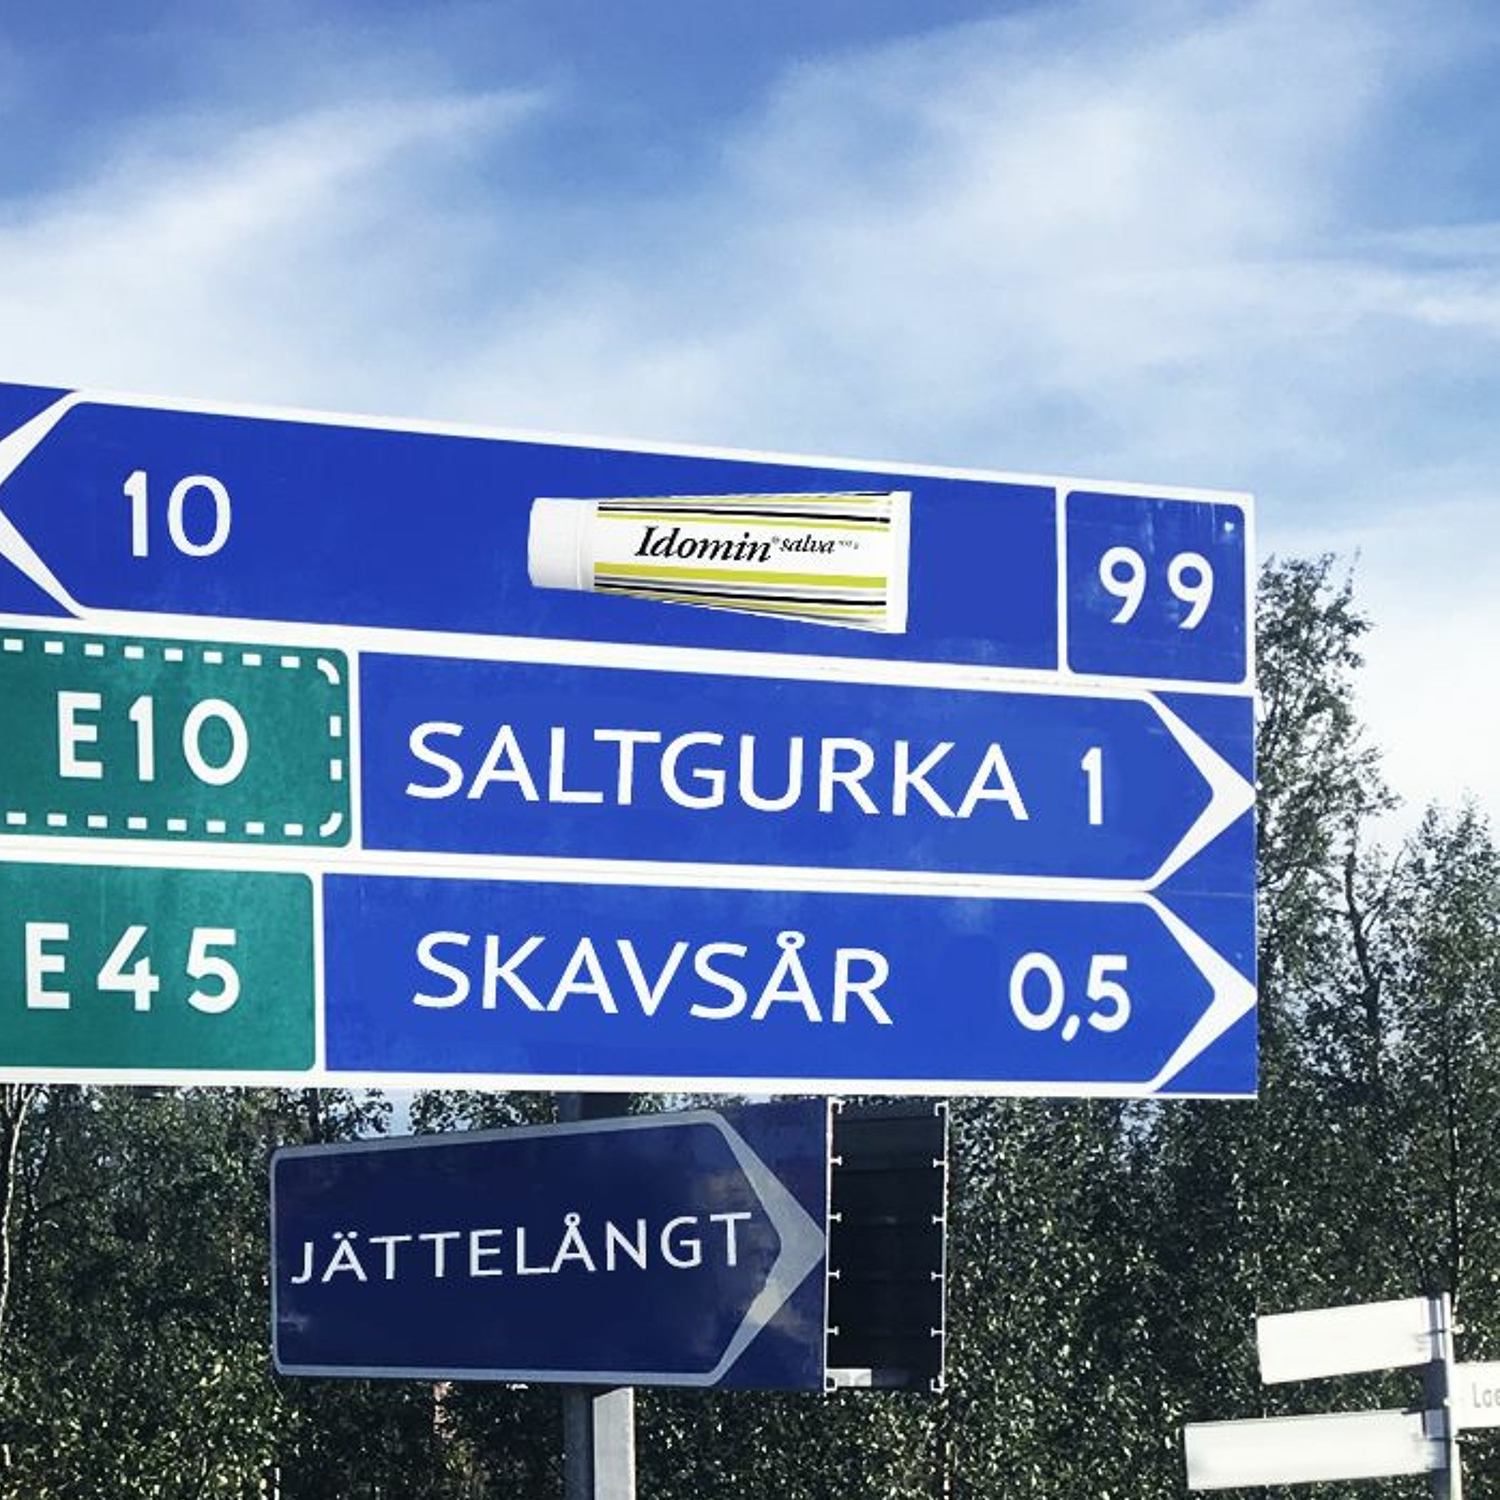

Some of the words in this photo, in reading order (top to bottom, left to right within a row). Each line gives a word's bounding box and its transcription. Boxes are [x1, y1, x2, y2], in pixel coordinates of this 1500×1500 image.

[123, 470, 231, 557] 10
[634, 526, 771, 563] Idomin
[1099, 546, 1214, 629] 99
[58, 691, 249, 785] E10
[406, 722, 1029, 821] SALTGURKA
[1081, 747, 1102, 825] 1
[25, 922, 240, 1014] E45
[413, 931, 892, 1024] SKAVSÅR
[1010, 952, 1131, 1041] 0,5
[291, 1212, 752, 1284] JÄTTELÅNGT
